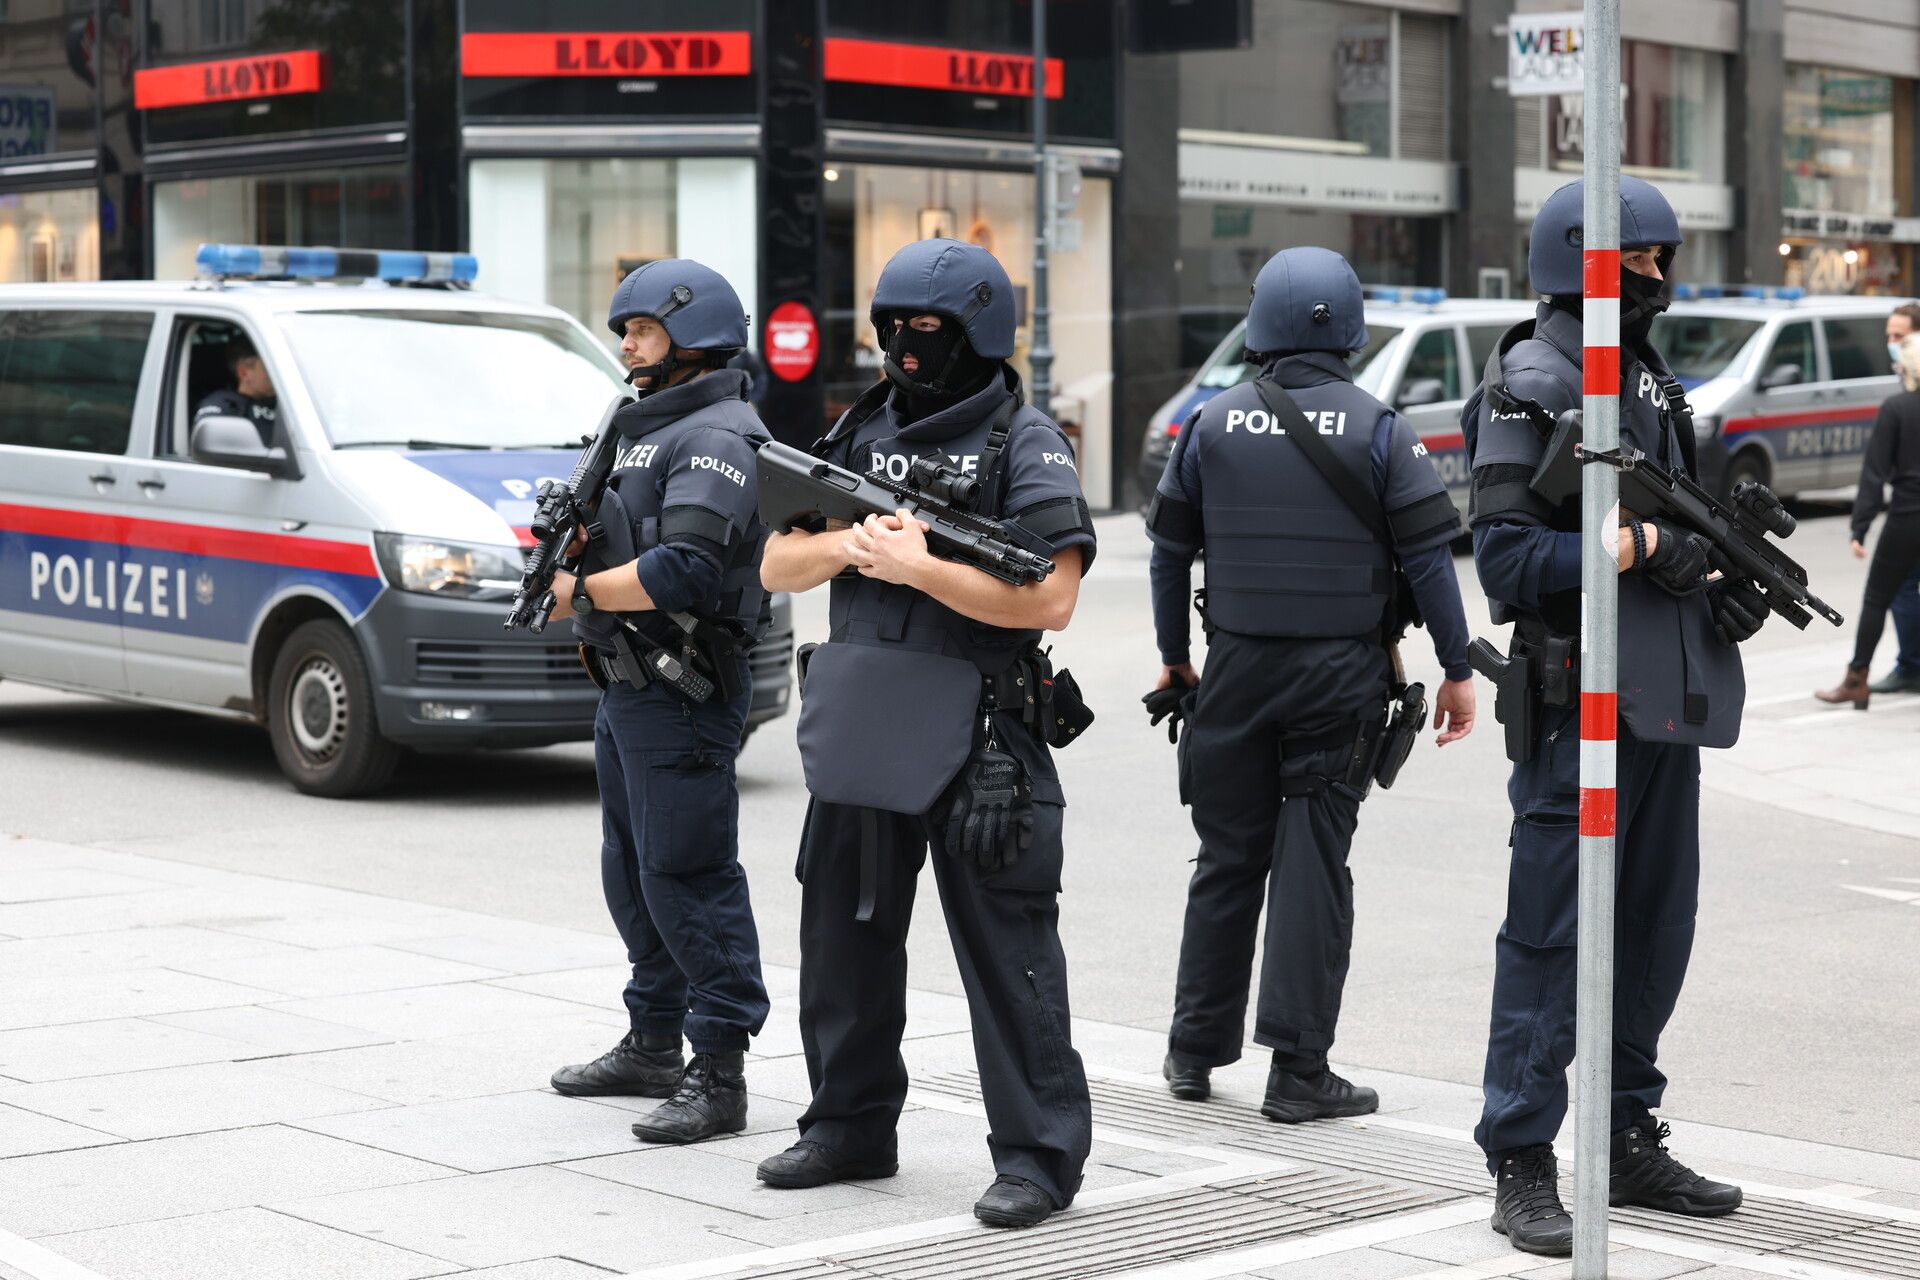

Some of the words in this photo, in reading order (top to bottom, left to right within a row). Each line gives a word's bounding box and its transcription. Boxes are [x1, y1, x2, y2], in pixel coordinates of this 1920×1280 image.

[556, 39, 723, 70] LLOYD
[204, 60, 291, 96] LLOYD
[1786, 427, 1862, 455] POLIZEI
[691, 456, 747, 487] POLIZEI
[31, 551, 187, 620] POLIZEI
